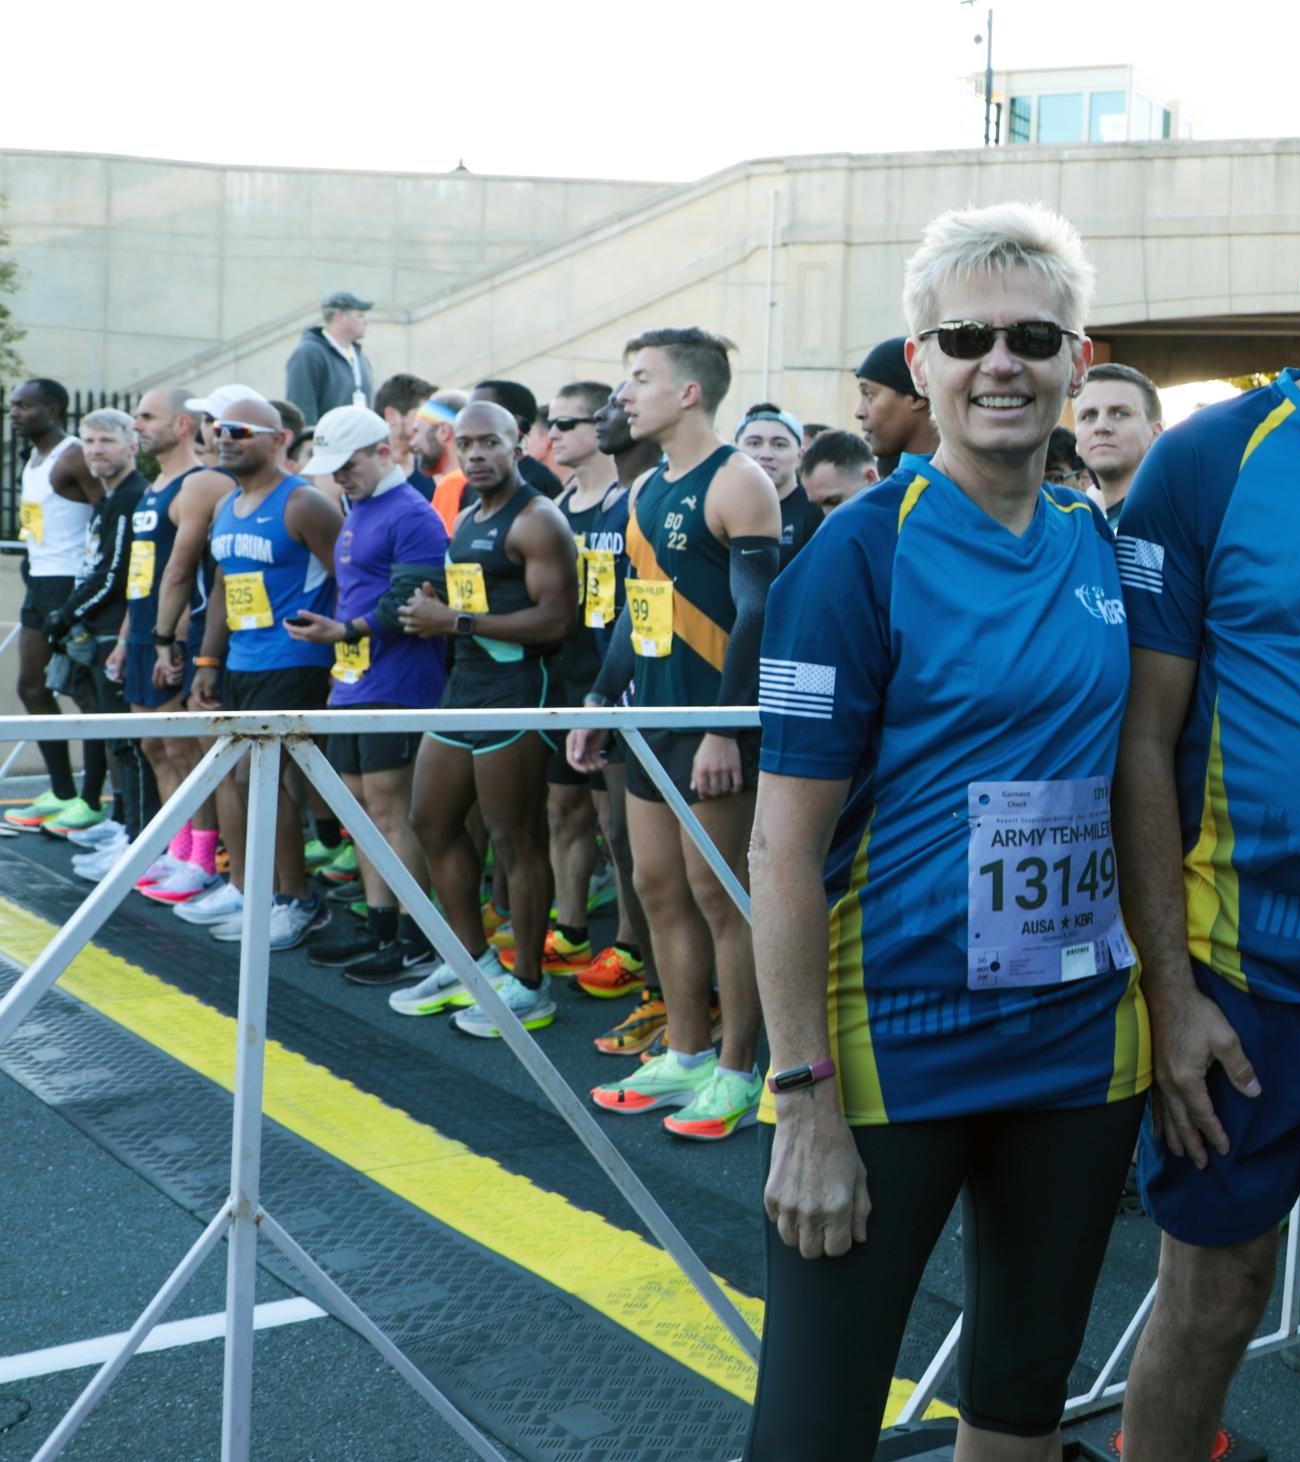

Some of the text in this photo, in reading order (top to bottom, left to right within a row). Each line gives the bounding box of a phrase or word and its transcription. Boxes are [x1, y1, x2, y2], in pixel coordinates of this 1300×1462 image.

[667, 531, 688, 551] 22
[991, 820, 1110, 848] ARMY TEN-MILER
[979, 847, 1116, 912] 13149
[1021, 919, 1055, 936] AUSA
[1074, 912, 1094, 929] KBR
